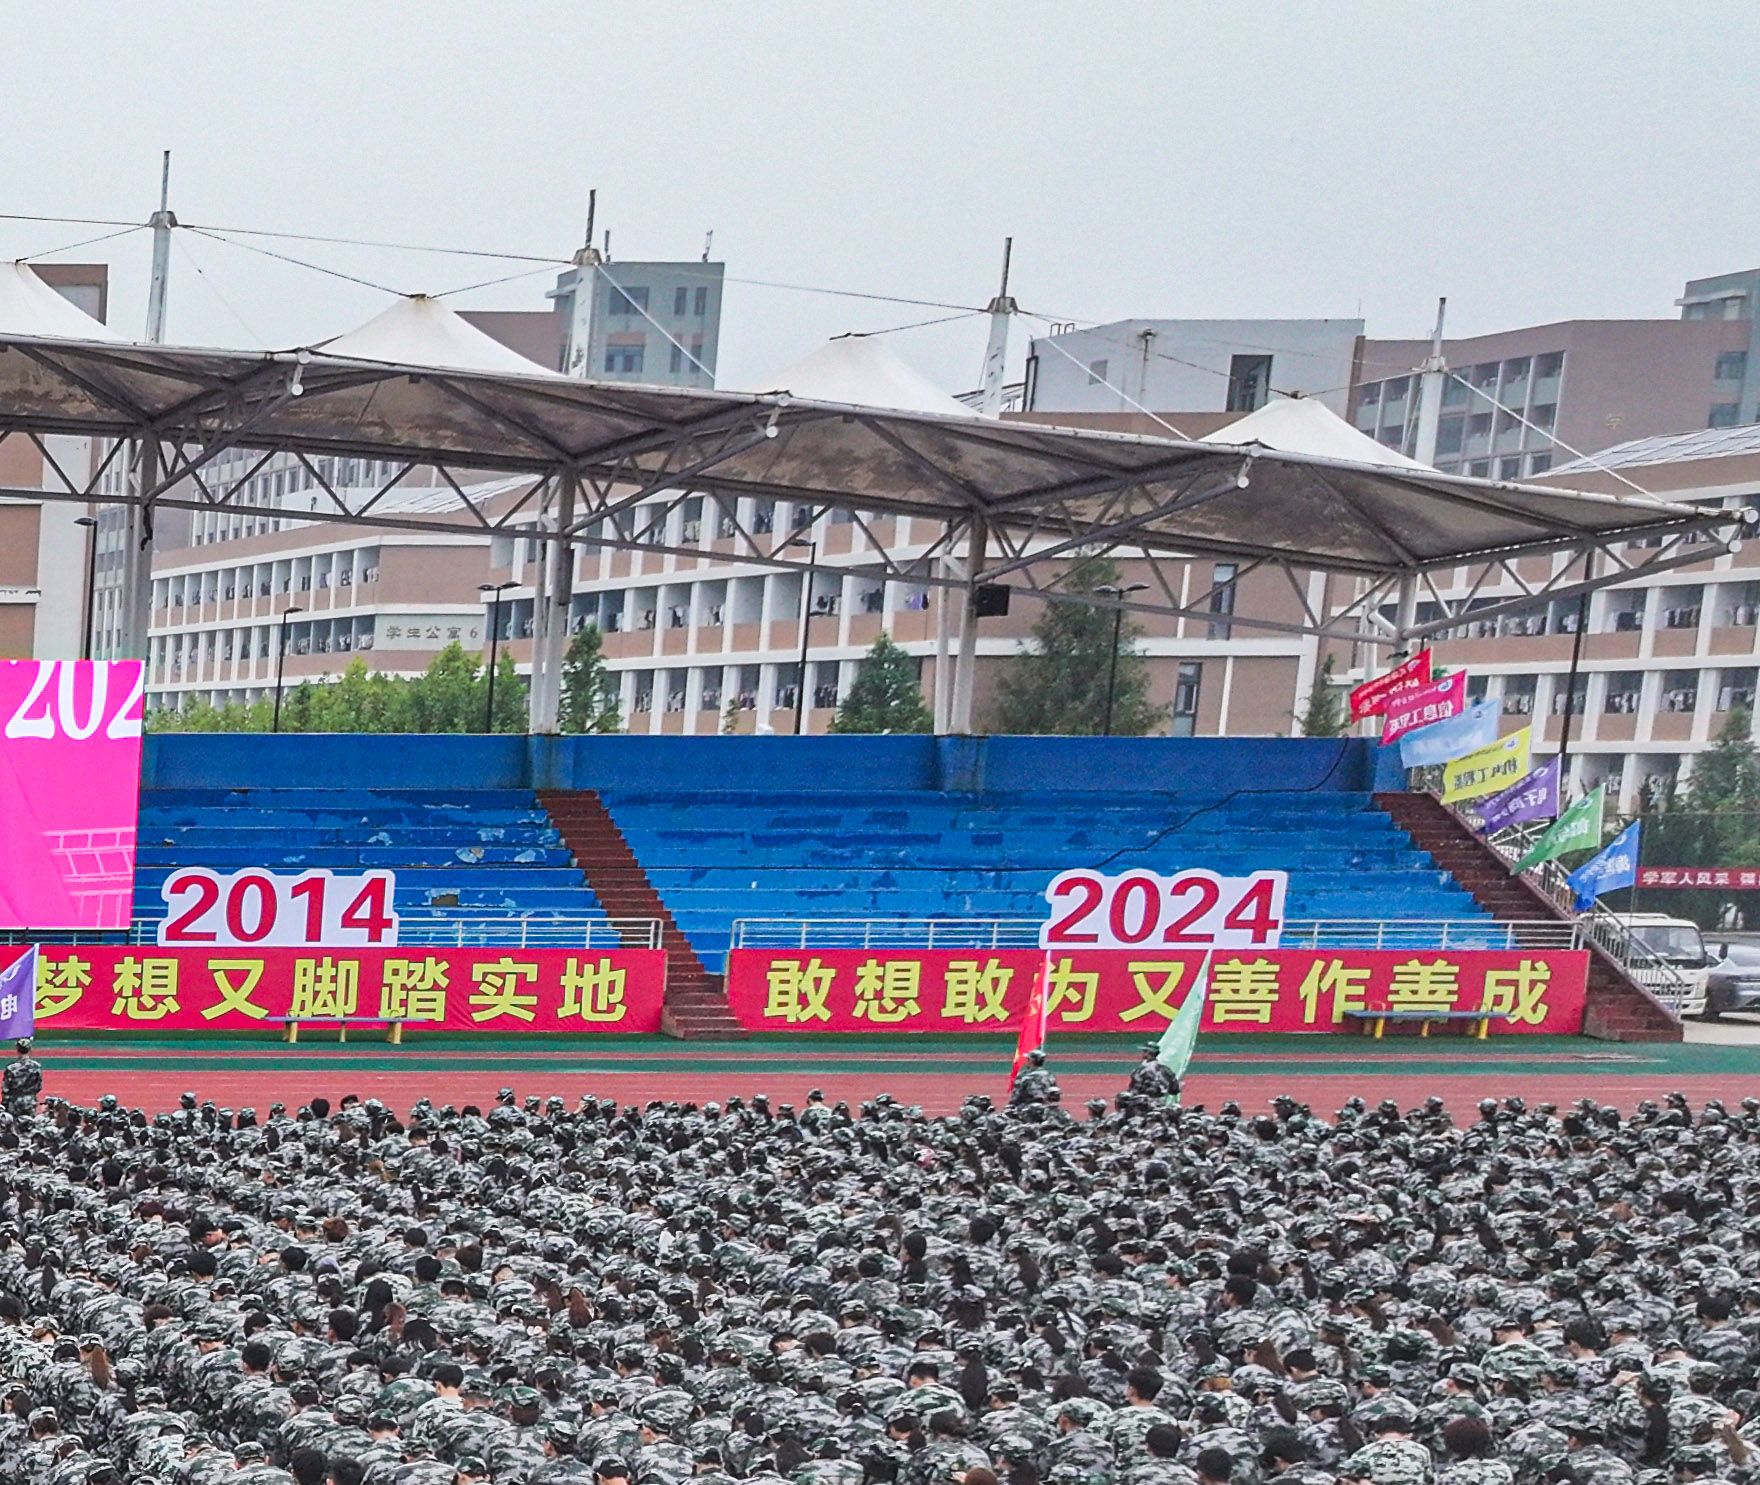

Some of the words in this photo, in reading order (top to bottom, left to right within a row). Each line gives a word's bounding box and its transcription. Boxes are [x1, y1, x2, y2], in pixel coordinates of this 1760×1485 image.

[165, 875, 393, 943] 2014
[1047, 877, 1281, 944] 2024
[1642, 871, 1730, 886] 学军人风采
[1740, 872, 1760, 885] 强
[764, 960, 1551, 1026] 敢想敢为又善作善成
